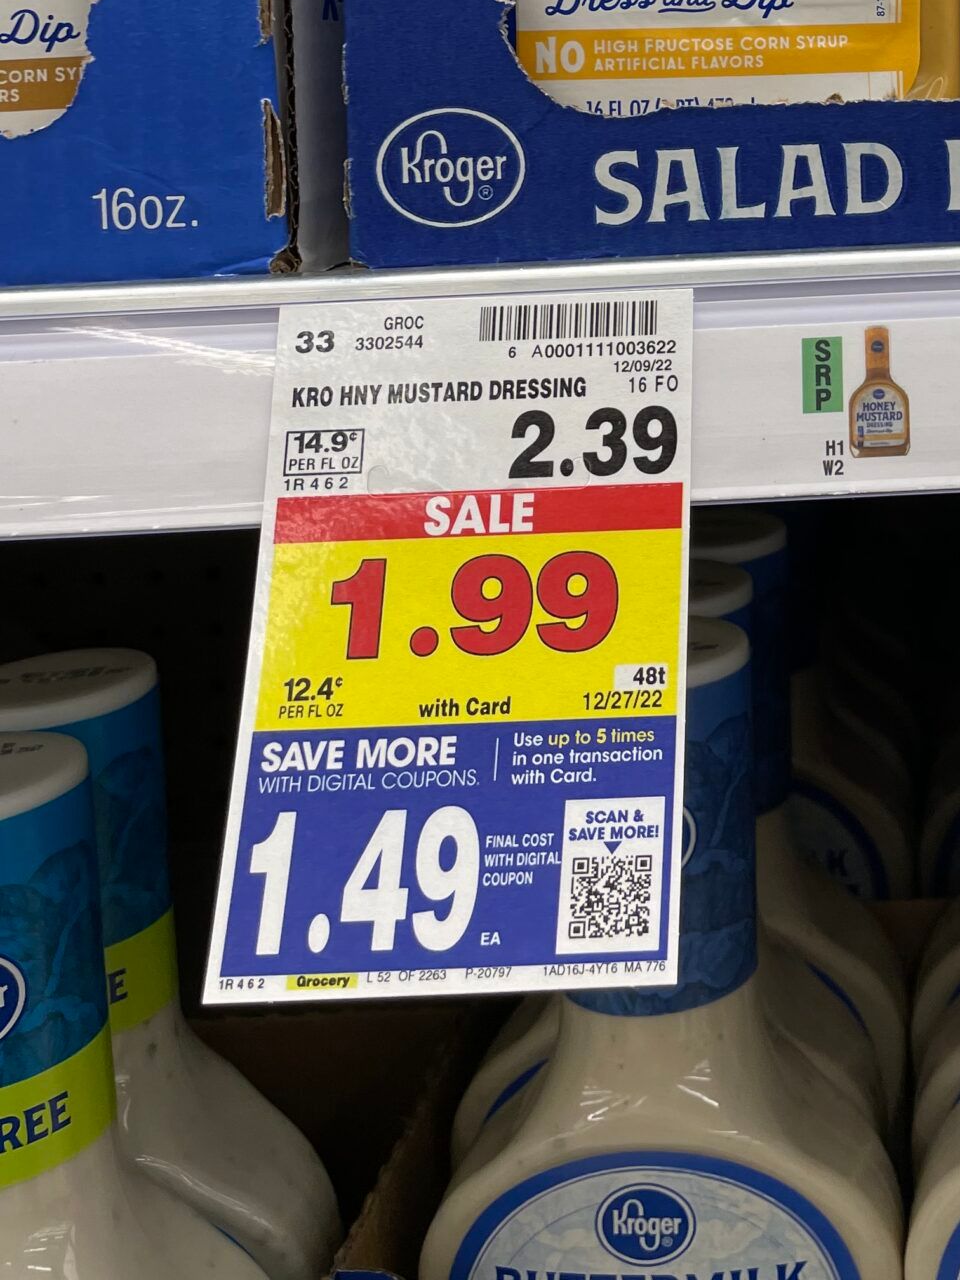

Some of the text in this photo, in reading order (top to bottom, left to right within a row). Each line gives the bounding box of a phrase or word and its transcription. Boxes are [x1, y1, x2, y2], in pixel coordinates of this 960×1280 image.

[0, 9, 81, 53] Dip
[593, 34, 848, 55] HIGH FRUCTOSE CORN SYRUP
[534, 36, 585, 74] NO
[593, 54, 764, 72] ARTIFICIAL FLAVORS
[401, 130, 507, 206] Kroger
[595, 141, 903, 226] SALAD
[384, 316, 424, 331] GROC
[295, 330, 424, 354] 33 3302544
[532, 340, 677, 358] A0001111003622
[614, 359, 673, 373] 12/09/22
[291, 376, 587, 408] KRO HNY MUSTARD DRESSING
[628, 375, 679, 394] 16 FO
[862, 401, 896, 412] HONEY
[856, 411, 903, 422] MUSTARD
[508, 405, 678, 480] 2.39
[825, 440, 844, 456] H1
[288, 456, 360, 472] PER FL OZ
[823, 460, 844, 476] W2
[424, 493, 535, 537] SALE
[330, 550, 619, 660] 1.99
[632, 666, 666, 686] 48t
[419, 696, 511, 718] with Card
[583, 690, 663, 711] 12/27/22
[278, 703, 344, 719] PER FL OZ
[513, 729, 655, 750] Use up to 5 times
[261, 736, 457, 773] SAVE MORE
[512, 747, 663, 766] in one transaction
[258, 769, 480, 794] WITH DIGITAL COUPONS.
[511, 767, 596, 785] with Card.
[585, 809, 628, 824] SCAN
[485, 833, 554, 848] FINAL COST
[568, 825, 660, 841] SAVE MORE!
[484, 852, 562, 867] WITH DIGITAL
[249, 805, 480, 956] 1.49
[482, 871, 533, 886] COUPON
[480, 932, 501, 946] EA
[296, 975, 350, 988] Grocery
[418, 969, 446, 981] 2263
[465, 966, 512, 979] P-20797
[612, 1199, 682, 1251] Kroger
